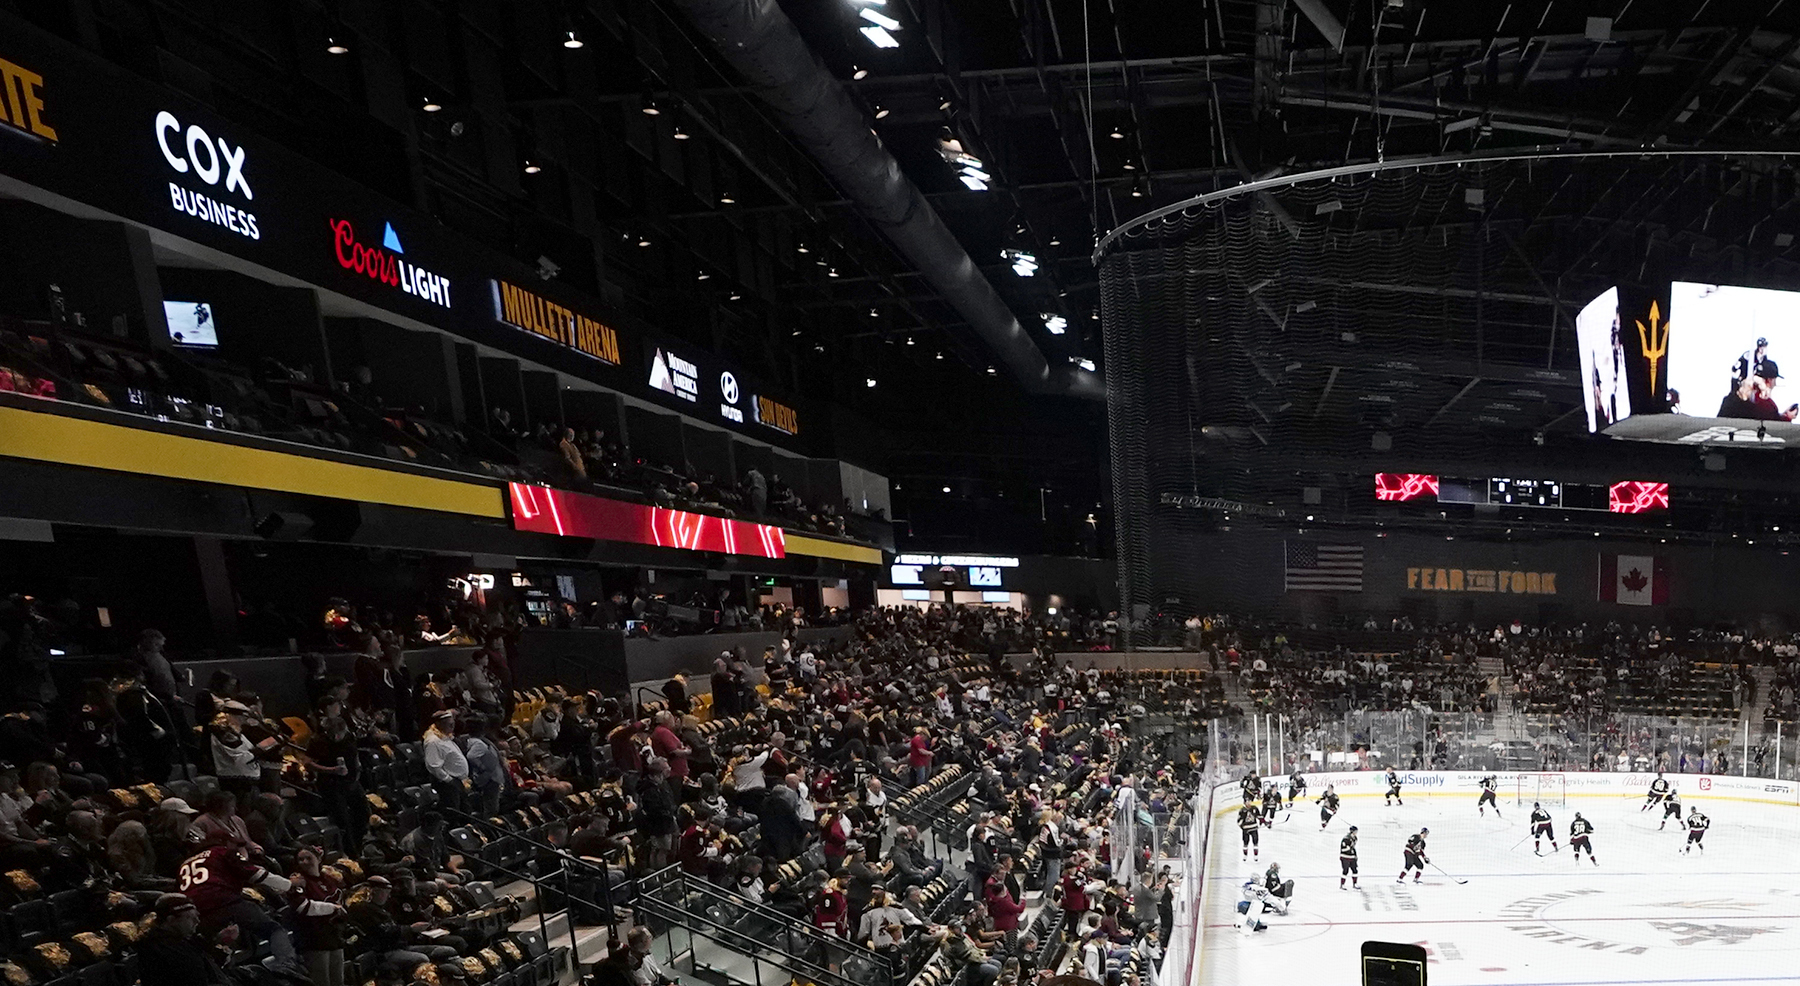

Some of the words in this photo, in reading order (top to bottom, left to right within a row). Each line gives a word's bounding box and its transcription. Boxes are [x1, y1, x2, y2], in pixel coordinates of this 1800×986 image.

[0, 57, 59, 142] TE
[155, 110, 253, 201] COX
[169, 182, 260, 240] BUSINESS
[330, 218, 399, 287] Coors
[398, 260, 451, 308] LIGHT
[501, 280, 576, 348] MULLETT
[576, 314, 622, 366] ARENA
[1407, 568, 1464, 591] FEAR
[1498, 570, 1557, 594] FORK
[1335, 778, 1359, 787] SPORTS
[1384, 773, 1445, 787] MdSupply
[1558, 777, 1585, 786] Dignity
[1586, 777, 1611, 785] Health
[179, 858, 210, 892] 35
